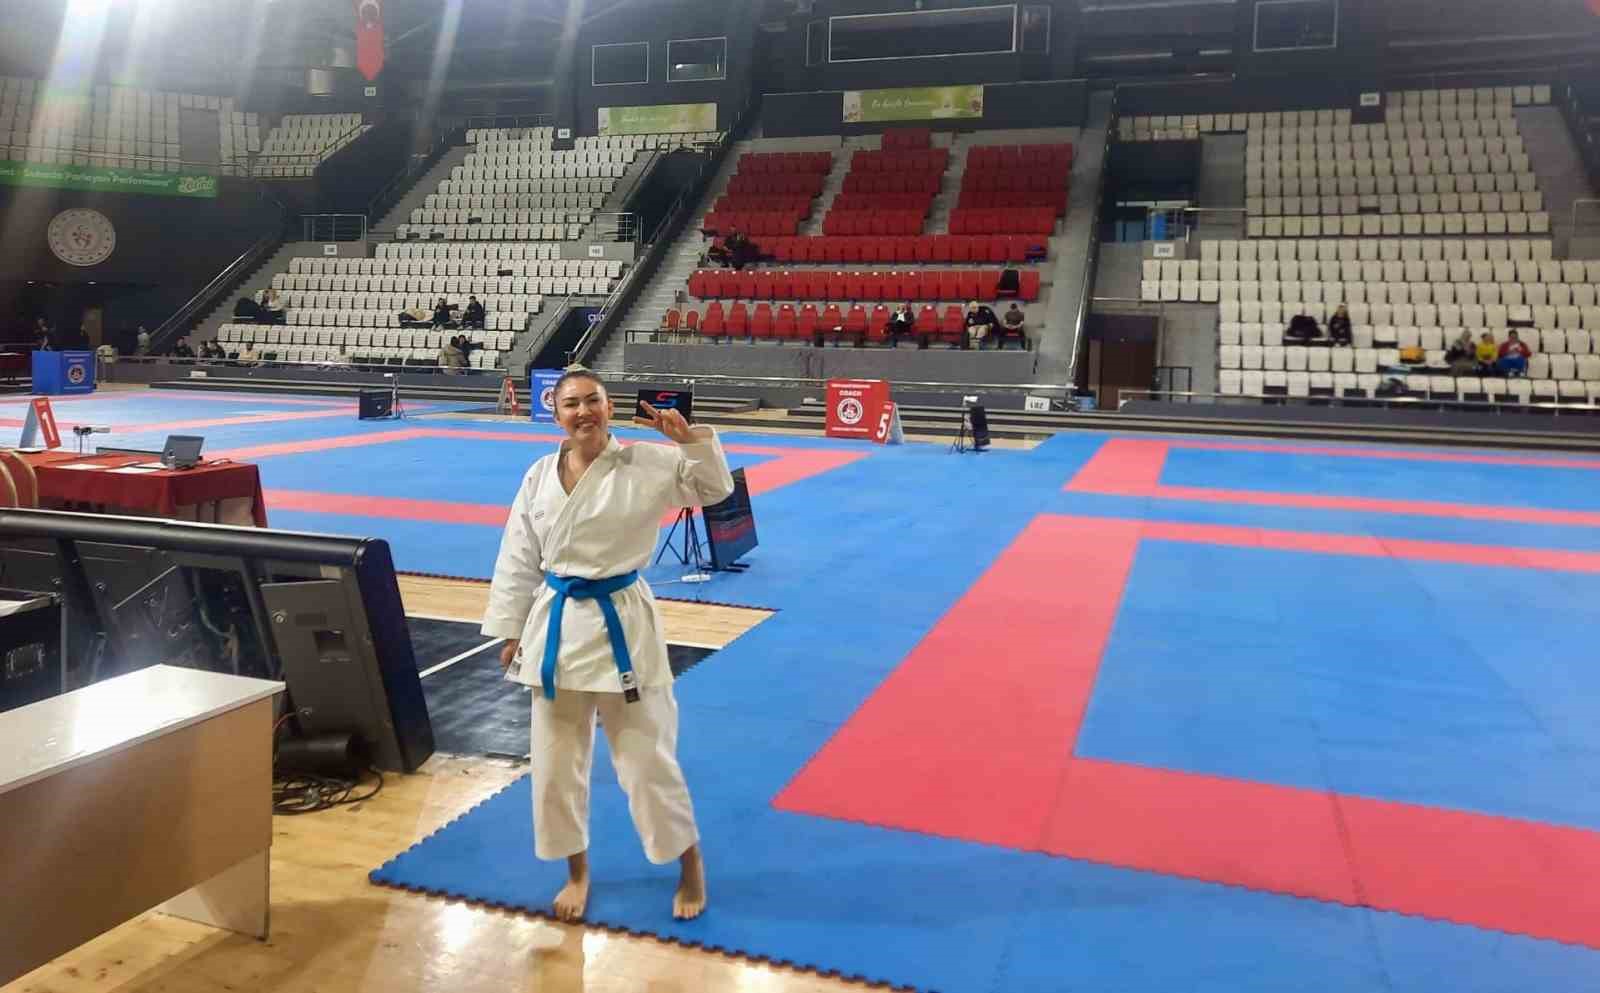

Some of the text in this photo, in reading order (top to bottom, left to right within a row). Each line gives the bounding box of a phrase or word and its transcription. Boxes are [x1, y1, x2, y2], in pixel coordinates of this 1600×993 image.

[839, 389, 862, 397] COACH
[41, 411, 55, 441] 1
[876, 413, 890, 439] 5
